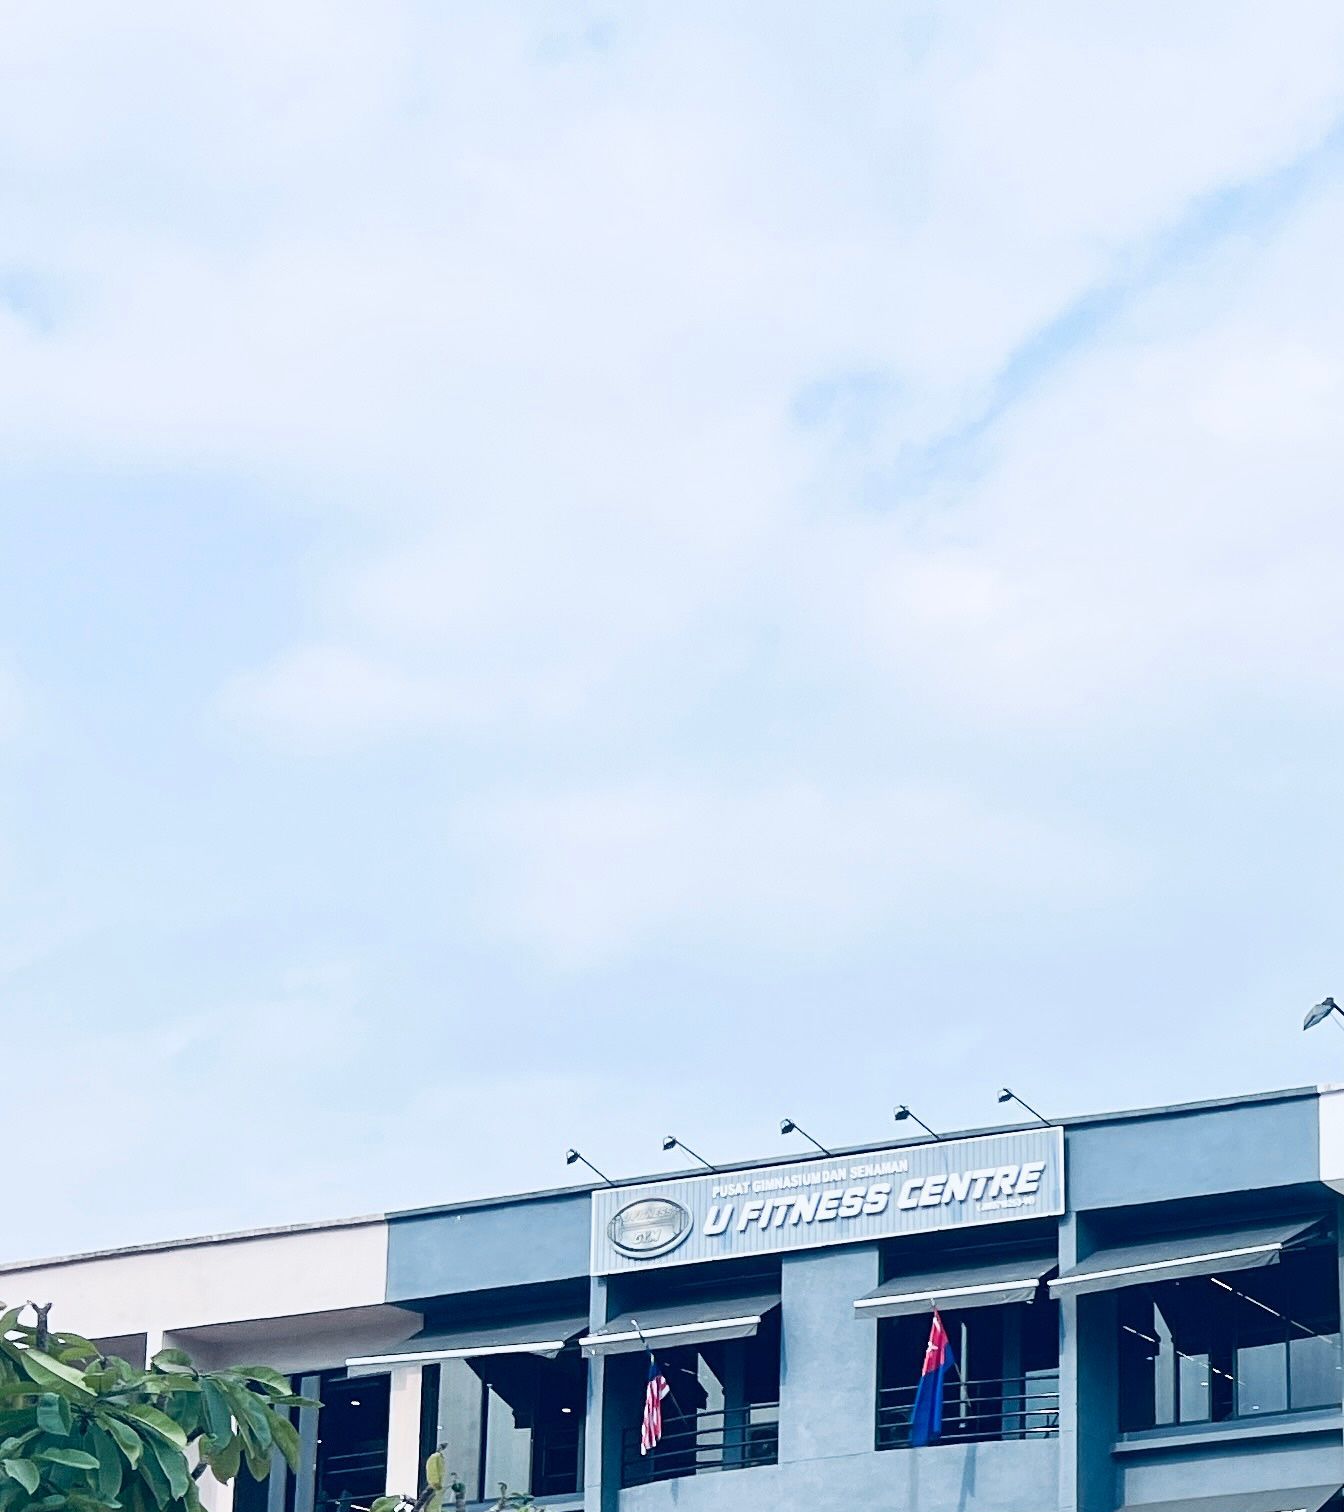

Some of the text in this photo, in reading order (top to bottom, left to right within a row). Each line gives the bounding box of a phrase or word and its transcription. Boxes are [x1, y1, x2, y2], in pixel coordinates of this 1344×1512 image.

[703, 1160, 1046, 1236] U FITNESS CENTRE
[712, 1158, 909, 1199] PUSAT GIMNASIUM DAN SENAMAN
